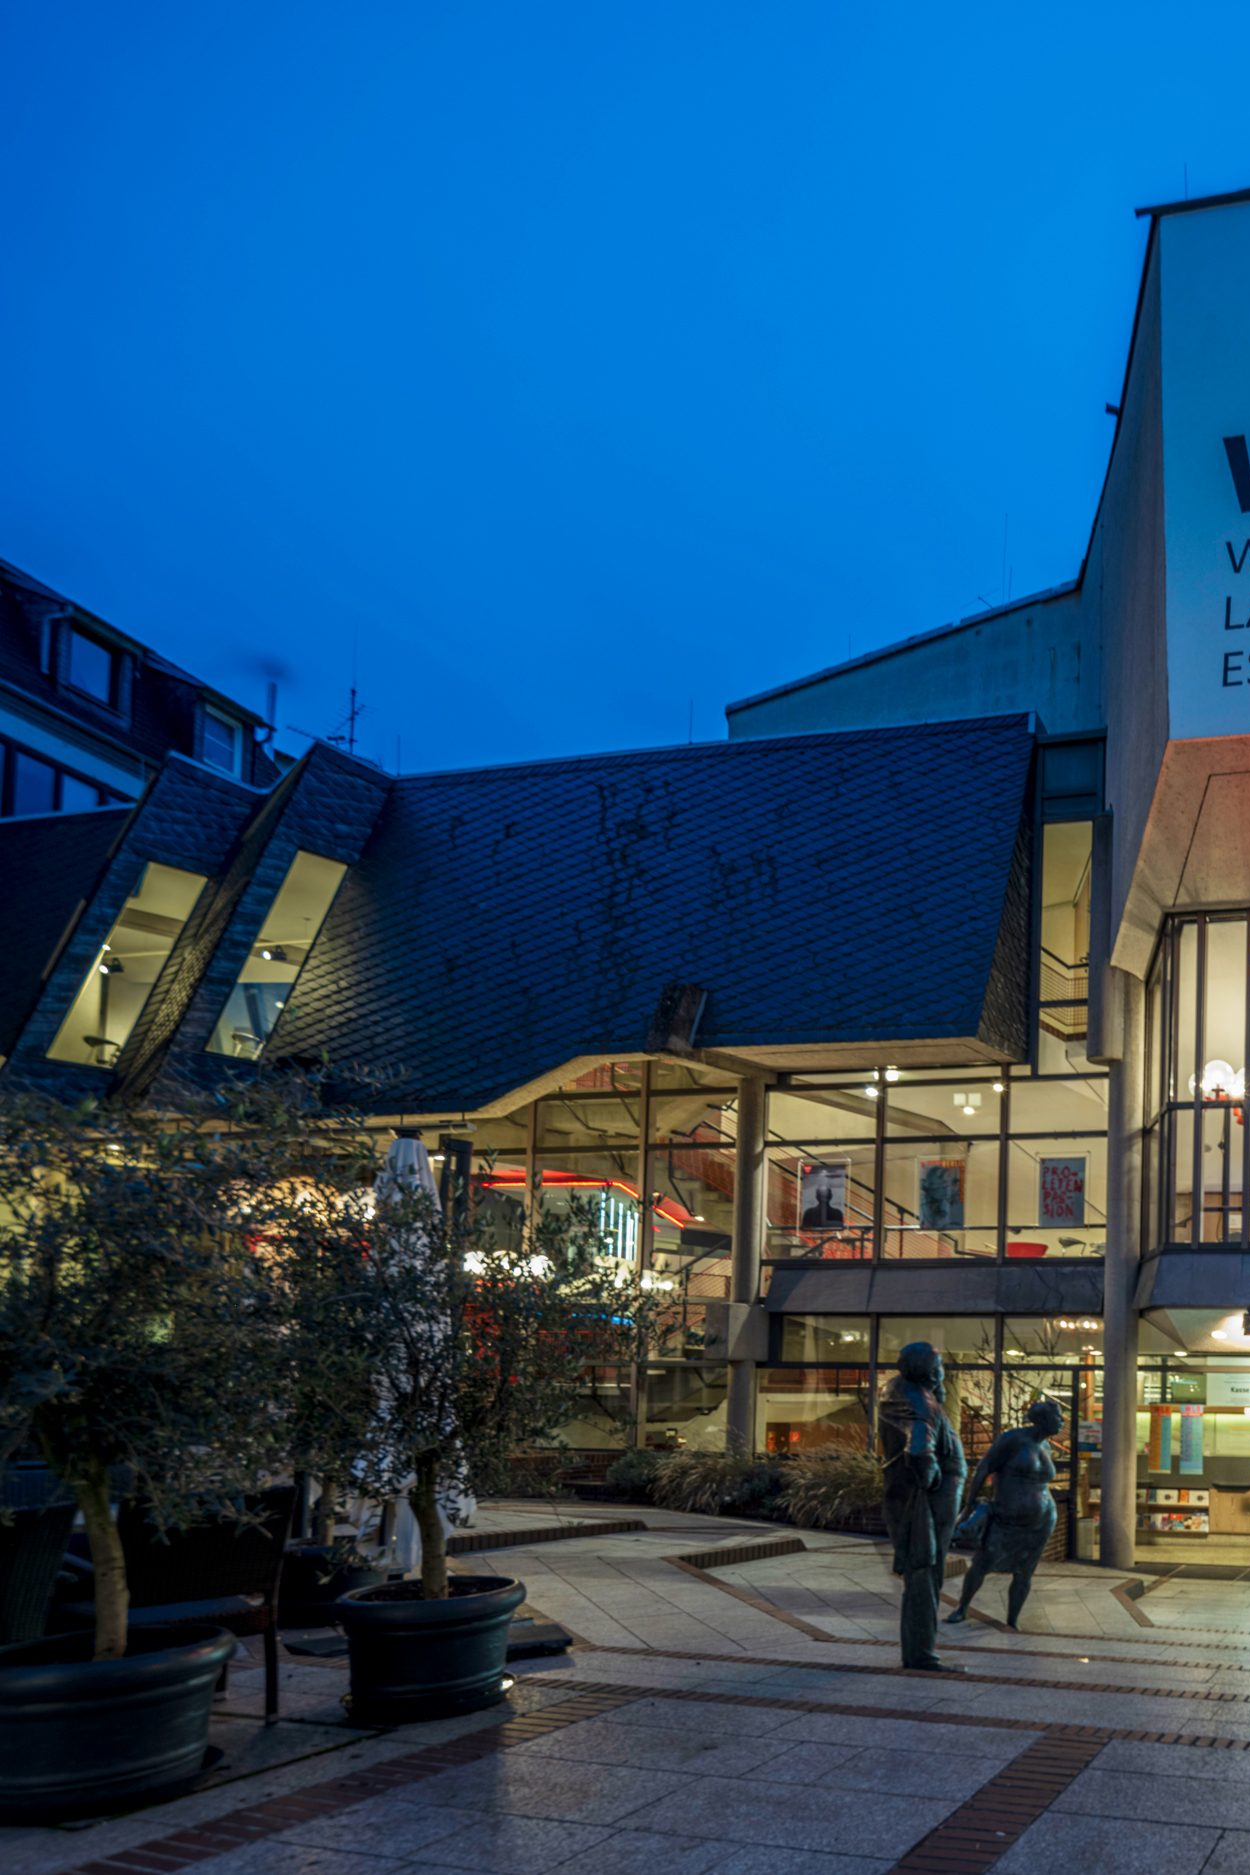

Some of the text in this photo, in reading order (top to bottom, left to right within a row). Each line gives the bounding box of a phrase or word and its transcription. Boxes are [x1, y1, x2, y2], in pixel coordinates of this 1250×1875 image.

[1042, 1177, 1083, 1193] LETEN
[1043, 1202, 1075, 1219] SION
[1230, 1386, 1250, 1394] Kasse
